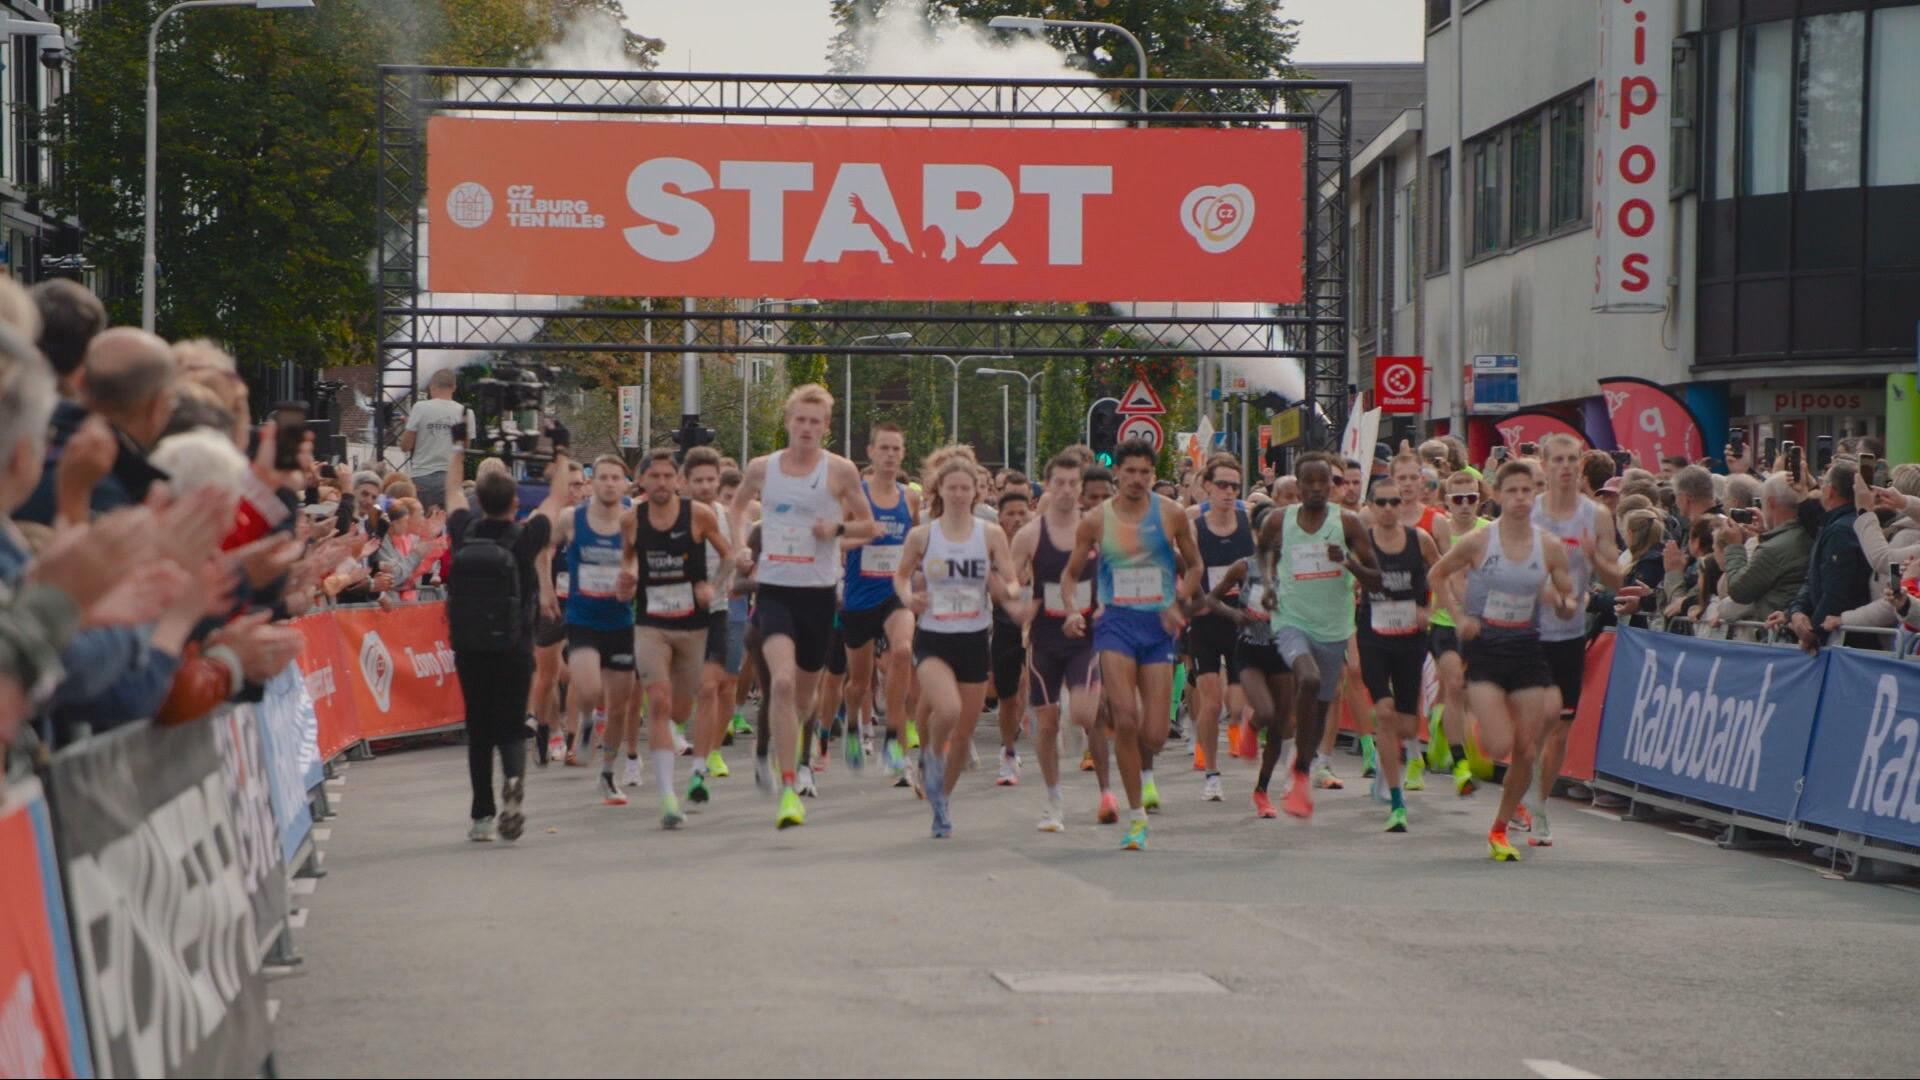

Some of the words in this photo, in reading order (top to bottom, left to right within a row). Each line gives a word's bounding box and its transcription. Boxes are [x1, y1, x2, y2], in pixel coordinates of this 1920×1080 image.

[1617, 0, 1657, 292] ipoos
[507, 184, 534, 199] CZ
[507, 199, 589, 214] TILBURG
[623, 157, 1114, 266] START
[1219, 208, 1234, 219] CZ
[507, 213, 545, 228] TEN
[548, 214, 606, 229] MILES
[1774, 390, 1861, 413] pipoos
[1623, 648, 1777, 793] Rabobank
